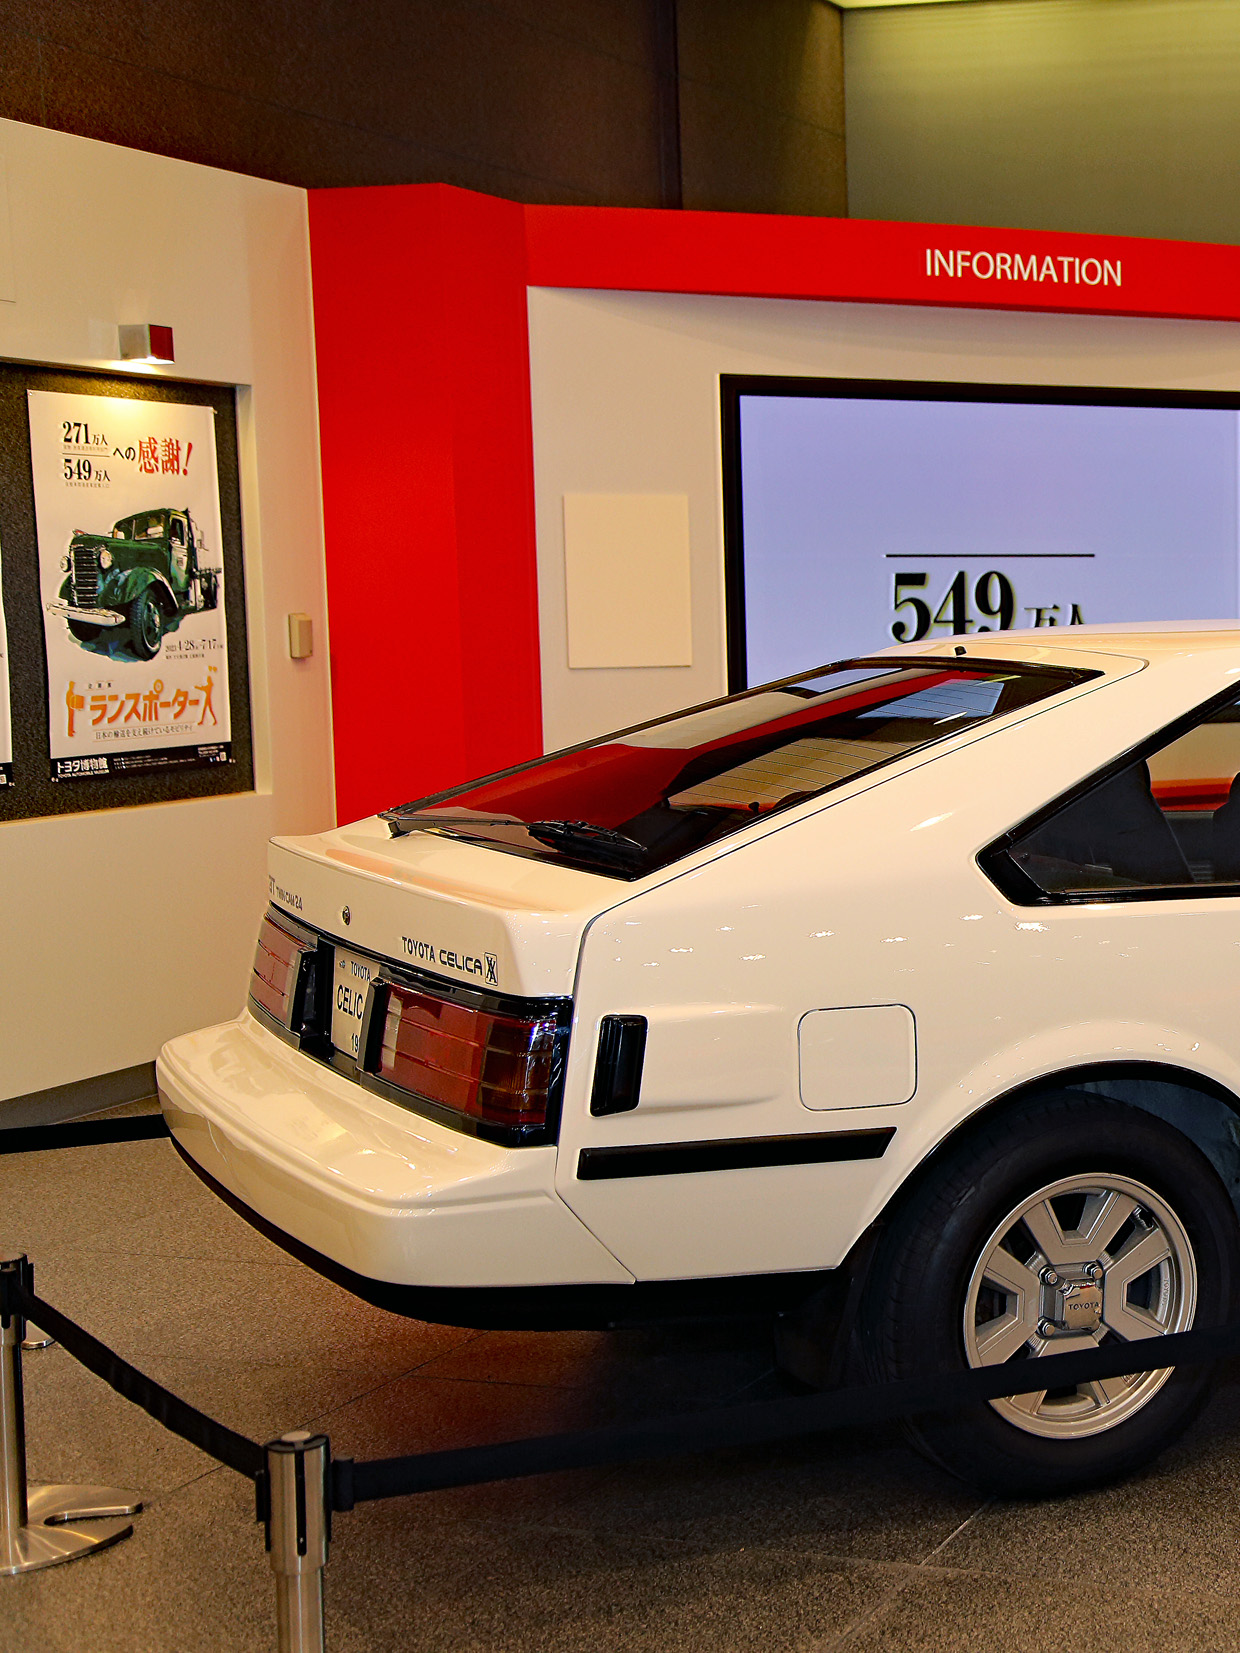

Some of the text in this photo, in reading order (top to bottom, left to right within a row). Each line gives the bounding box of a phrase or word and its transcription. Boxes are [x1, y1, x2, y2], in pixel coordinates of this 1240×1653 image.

[926, 248, 1122, 287] INFORMATION
[401, 936, 436, 963] TOYOTA
[439, 949, 483, 976] CELICA
[351, 960, 371, 981] TOYOTA
[337, 984, 364, 1020] CELIC
[351, 1033, 360, 1053] 19
[1068, 1301, 1099, 1310] TOYOTA
